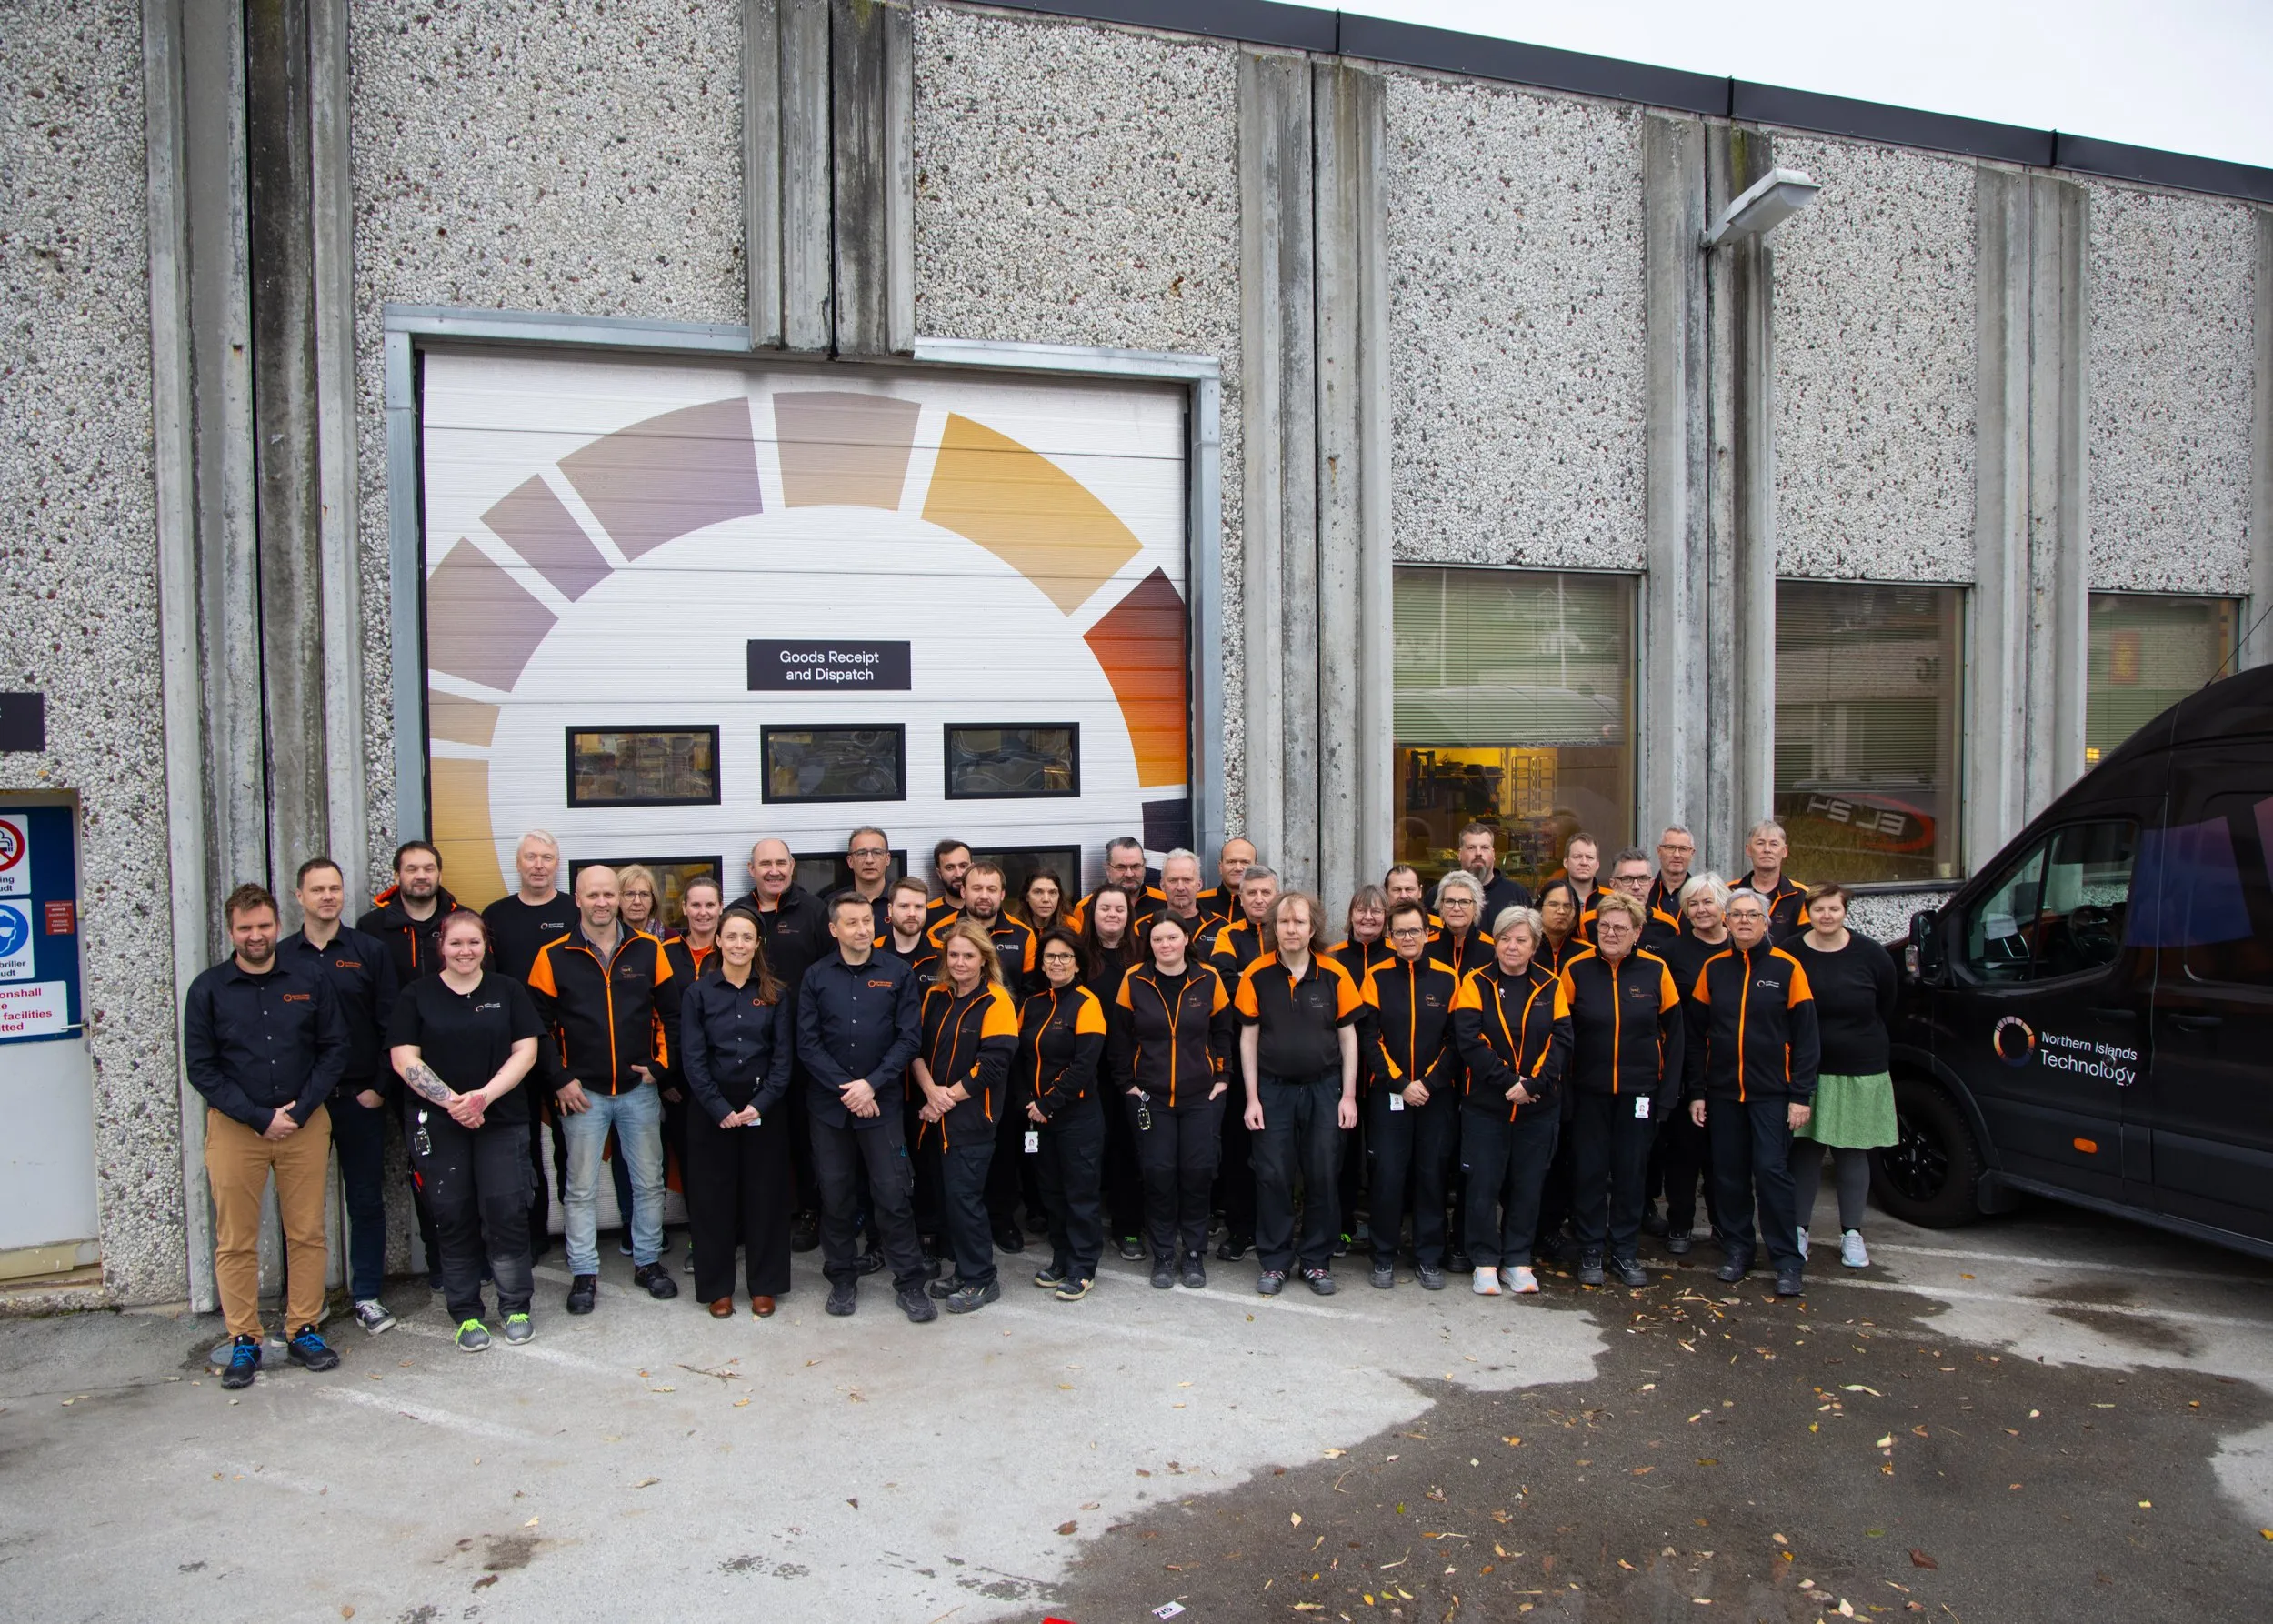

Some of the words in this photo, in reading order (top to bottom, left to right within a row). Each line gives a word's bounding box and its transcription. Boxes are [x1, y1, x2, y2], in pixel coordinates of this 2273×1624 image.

[779, 650, 826, 664] Goods
[828, 650, 880, 667] Receipt
[786, 668, 812, 681] and
[816, 667, 874, 684] Dispatch
[3, 1010, 53, 1020] facilities
[0, 1022, 24, 1032] tted
[2041, 1031, 2092, 1051] Northern
[2095, 1041, 2138, 1061] Islands
[2040, 1049, 2136, 1087] Technology
